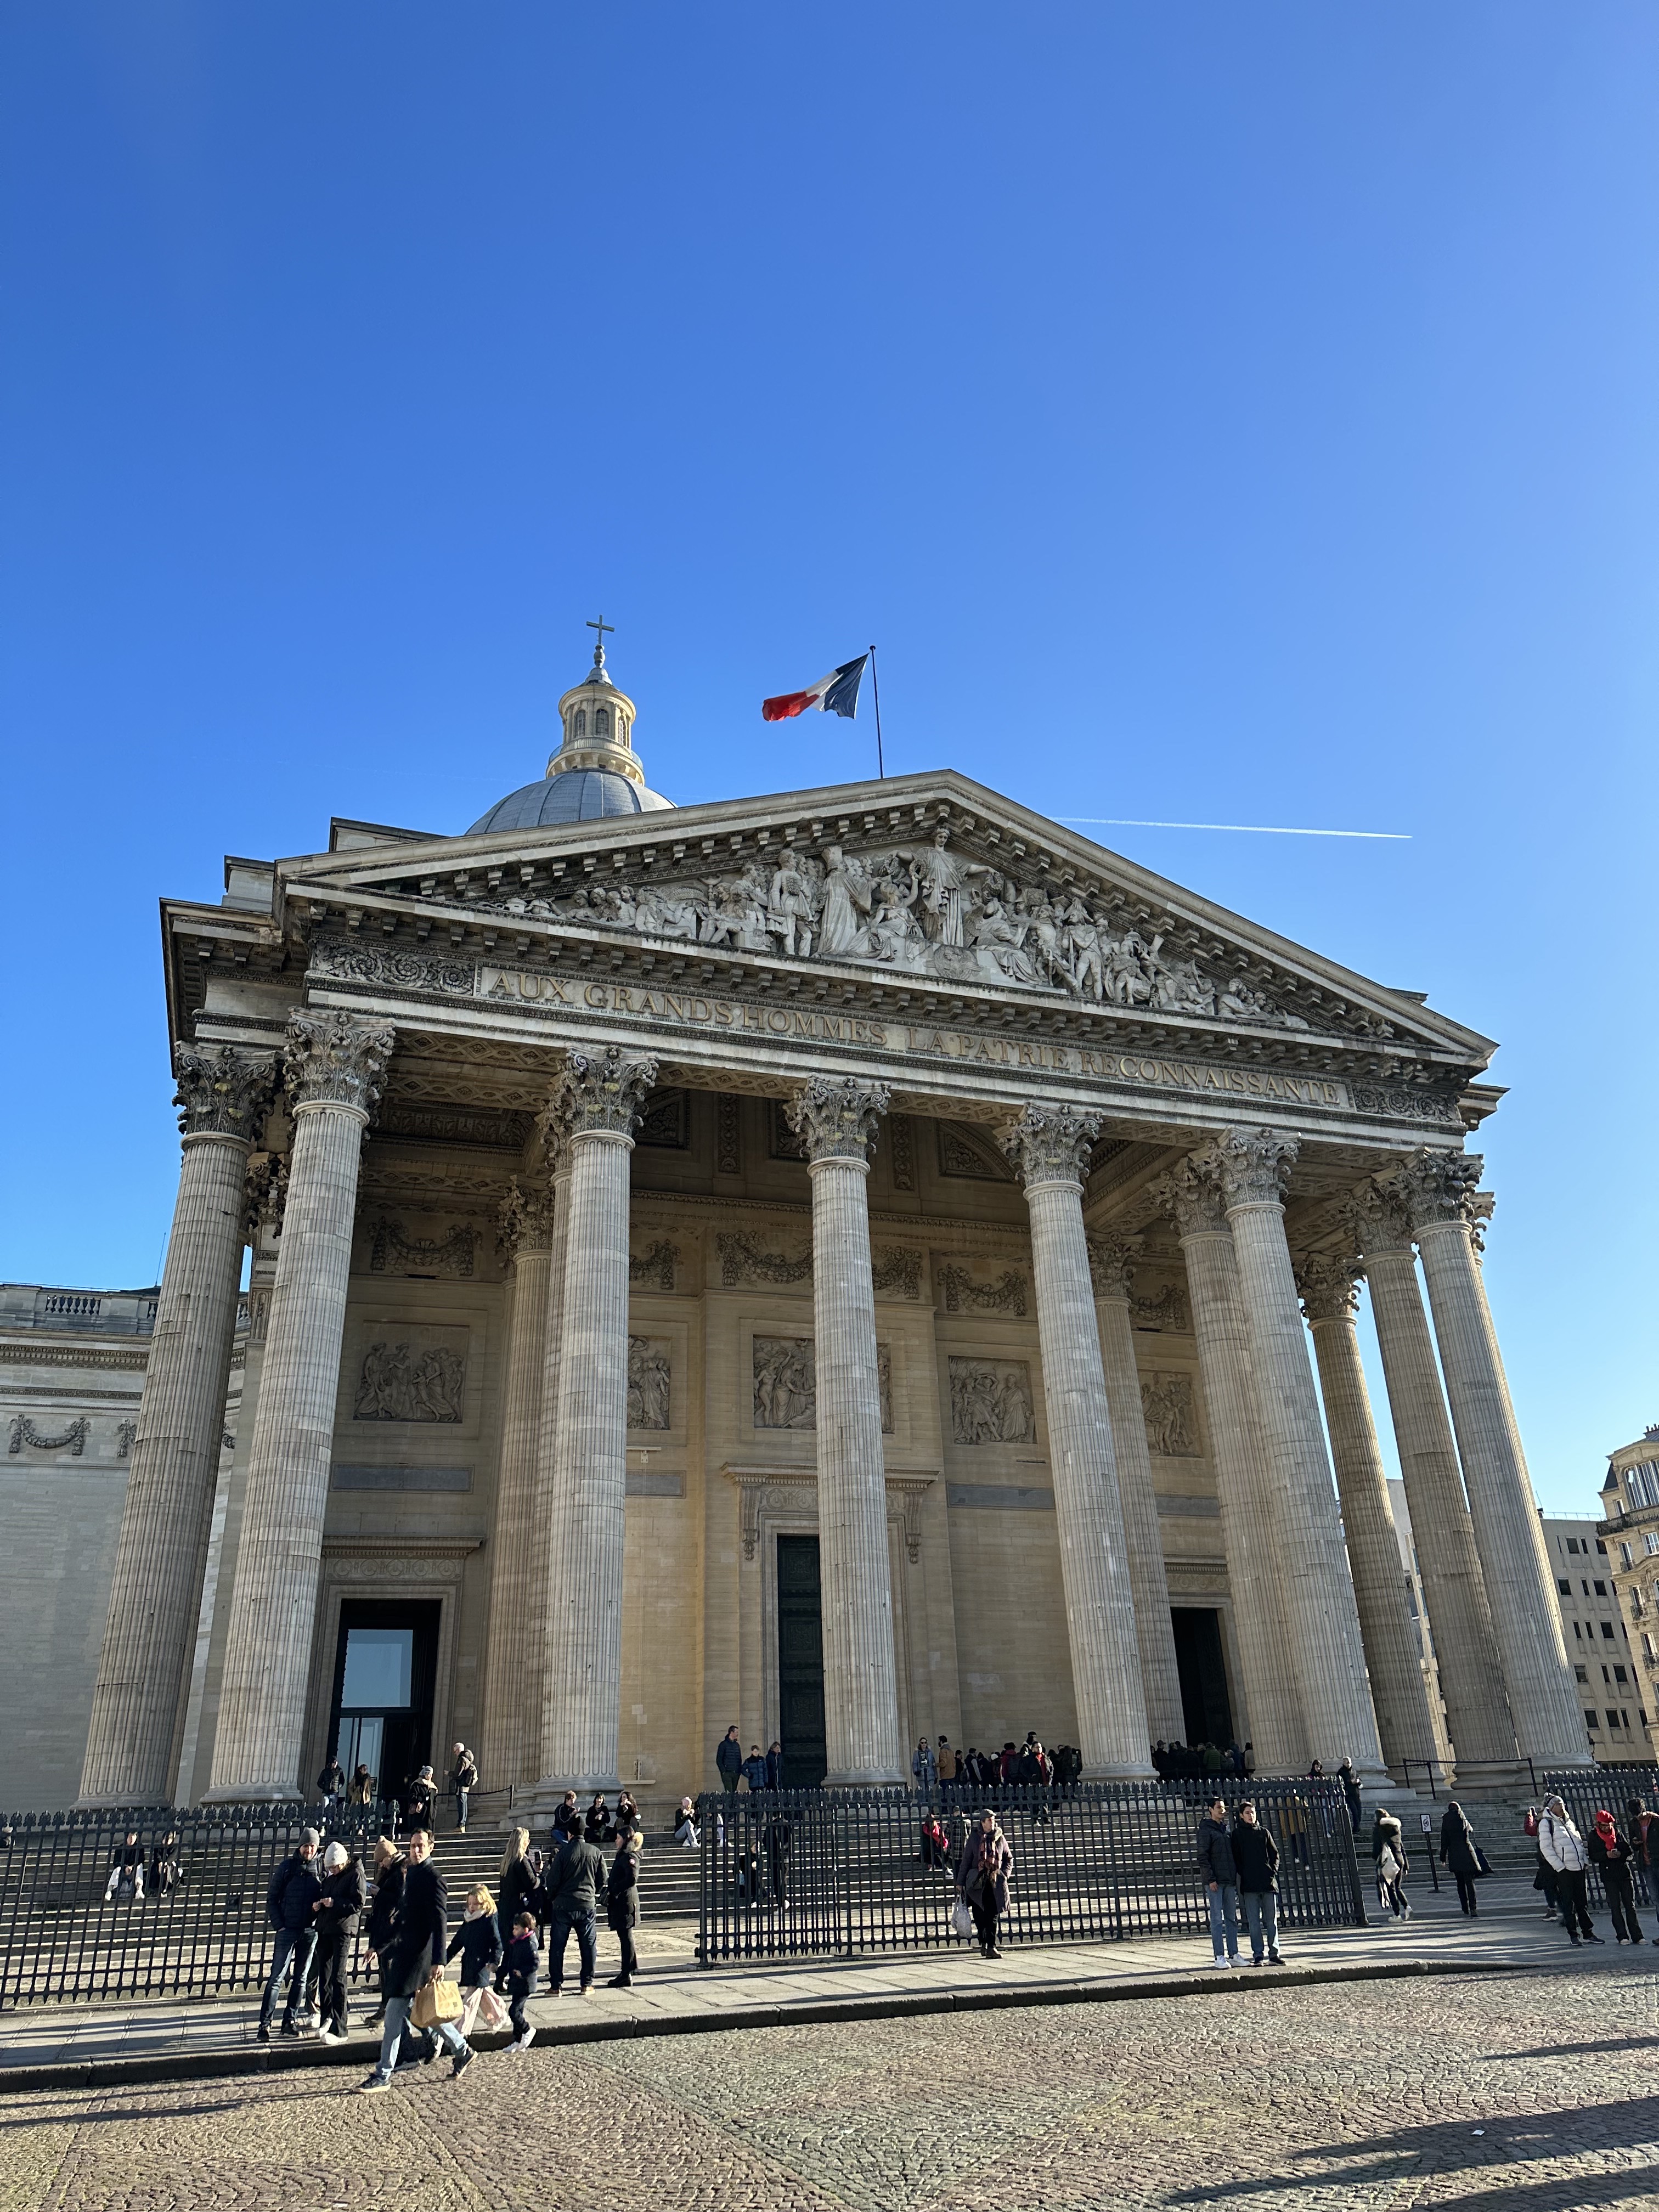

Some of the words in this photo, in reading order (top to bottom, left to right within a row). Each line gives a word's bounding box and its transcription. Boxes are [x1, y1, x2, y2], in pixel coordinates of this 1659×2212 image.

[488, 970, 574, 1003] AUX
[584, 983, 733, 1024] GRANDS
[741, 1005, 887, 1045] HOMMES
[908, 1028, 950, 1054] LA
[957, 1035, 1070, 1069] PATRIE
[1079, 1051, 1340, 1104] RECONNAISSANTE
